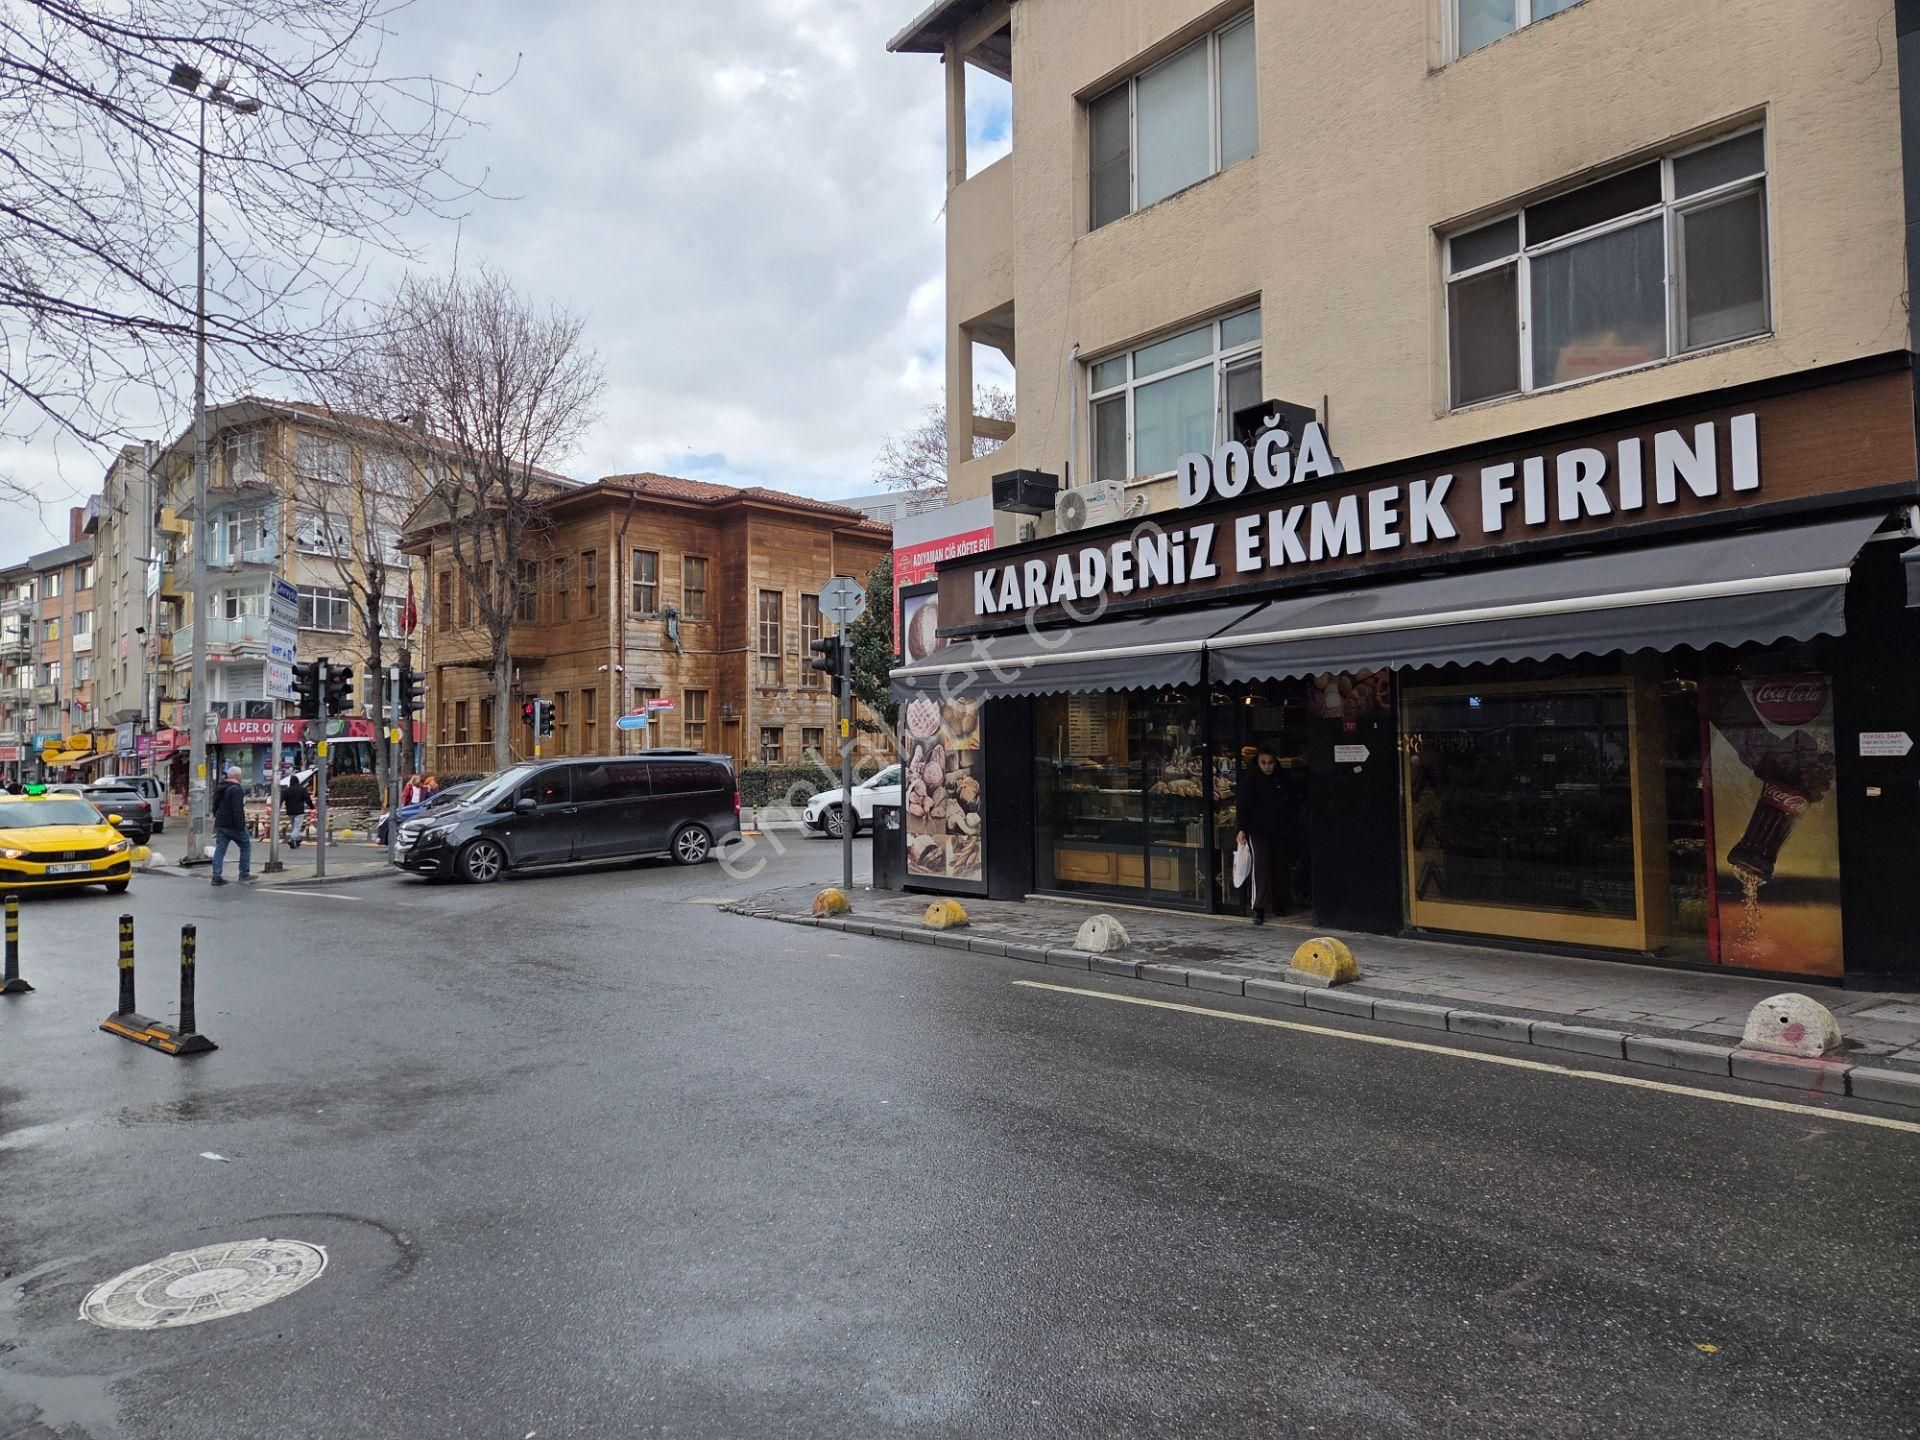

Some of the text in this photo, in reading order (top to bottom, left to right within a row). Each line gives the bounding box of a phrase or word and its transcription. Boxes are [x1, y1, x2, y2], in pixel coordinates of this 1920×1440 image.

[1177, 413, 1335, 508] DOĞA
[1235, 473, 1457, 573] EKMEK
[1480, 412, 1759, 533] FIRINI
[912, 548, 943, 567] ADIYAMAN
[957, 539, 978, 557] KÖFTE
[225, 721, 259, 734] ALPER
